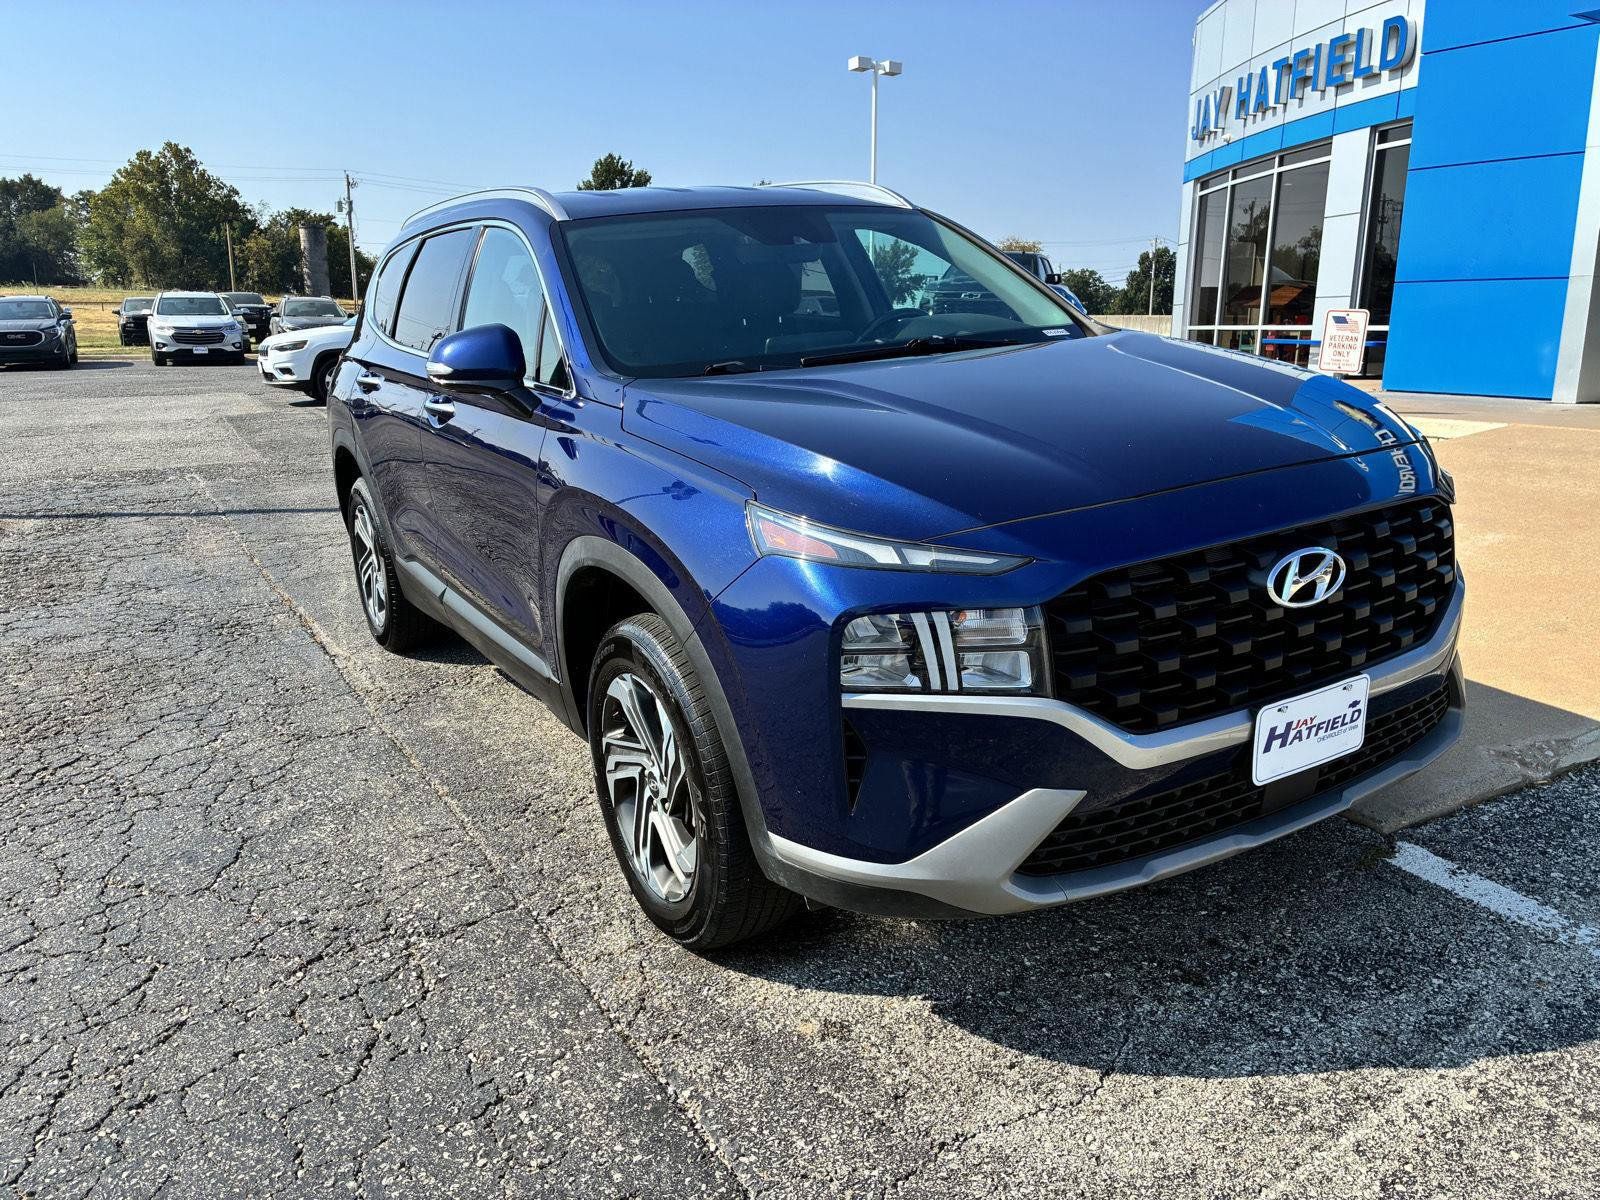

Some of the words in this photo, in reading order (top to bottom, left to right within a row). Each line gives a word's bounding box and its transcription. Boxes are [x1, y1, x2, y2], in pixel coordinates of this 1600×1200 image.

[1192, 87, 1230, 140] JAY
[1235, 15, 1415, 119] HATFIELD
[1328, 342, 1357, 351] PARKING
[1333, 349, 1351, 358] ONLY
[1263, 708, 1362, 754] HATFIELD
[1292, 715, 1317, 731] JAY
